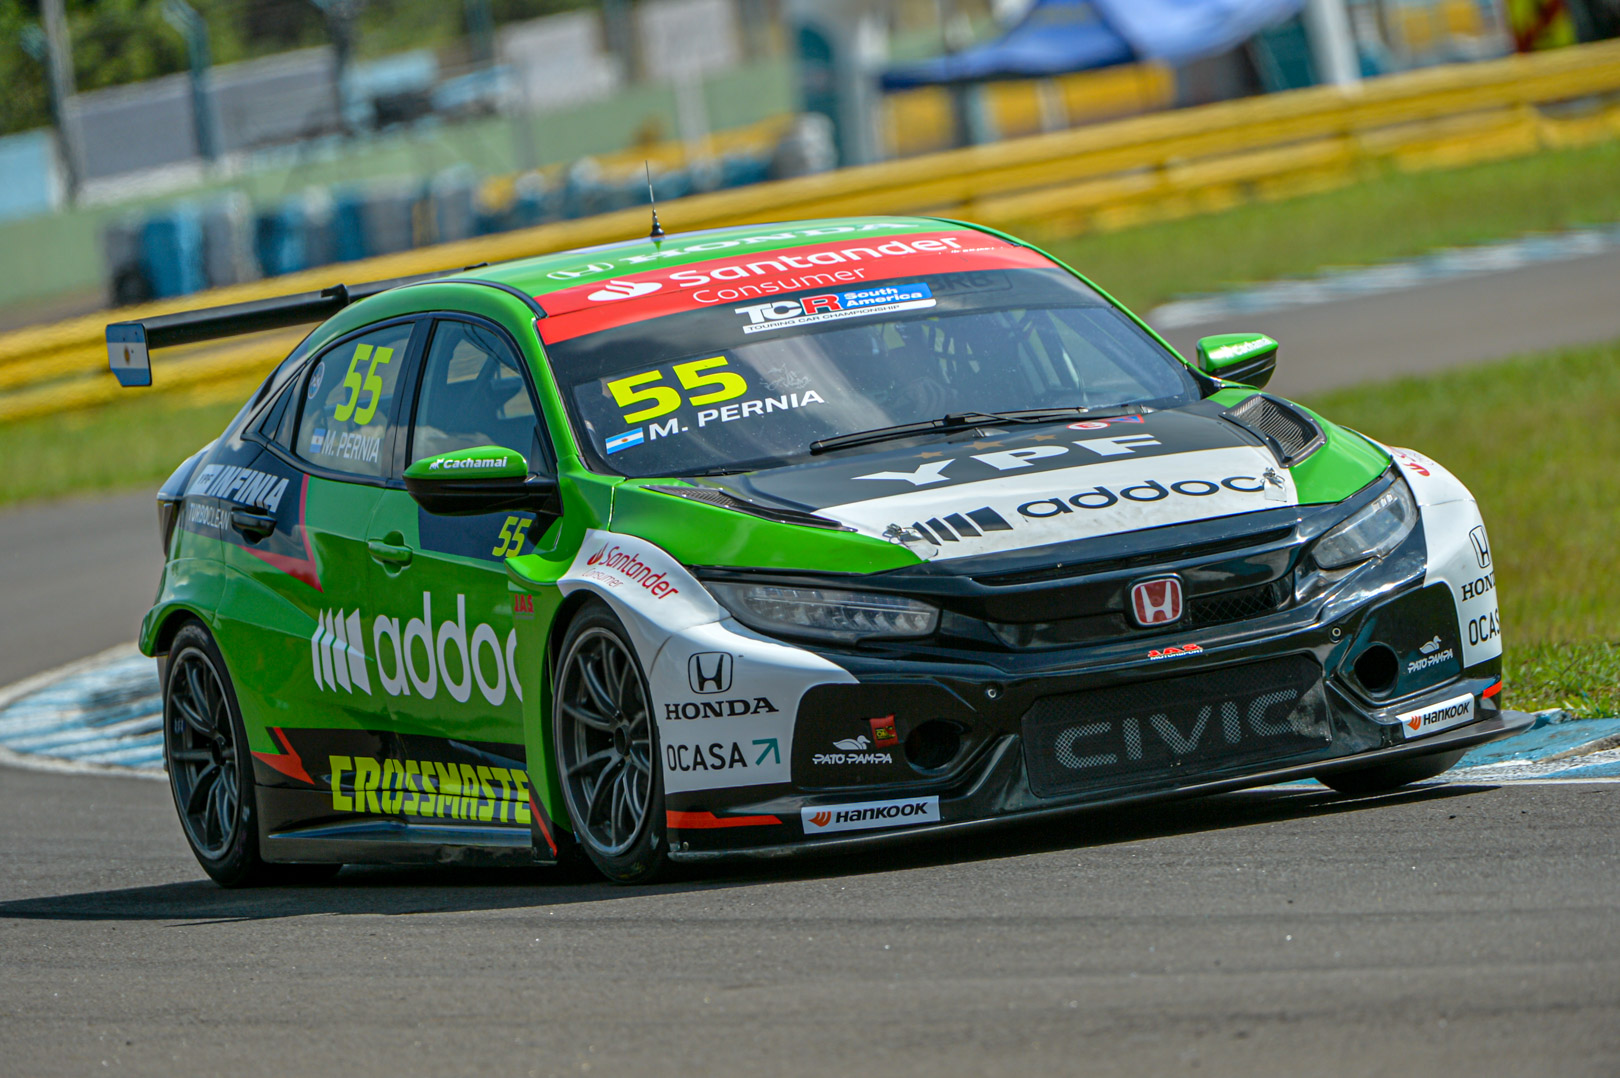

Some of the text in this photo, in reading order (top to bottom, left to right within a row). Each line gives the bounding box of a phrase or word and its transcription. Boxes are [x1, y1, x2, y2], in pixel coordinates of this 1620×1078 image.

[619, 222, 919, 264] HONDA
[669, 237, 961, 287] Santander
[693, 266, 865, 303] Consumer
[844, 287, 898, 299] South
[847, 292, 922, 308] America
[735, 293, 843, 324] TCR
[748, 304, 900, 331] TOURING CAR CHAMPIONSHIP
[334, 343, 394, 426] 55
[607, 355, 748, 424] 55
[649, 389, 825, 441] M. PERNIA
[321, 429, 381, 464] M. PERNIA
[443, 456, 508, 469] Cachamai
[851, 433, 1163, 486] YPF
[205, 465, 290, 514] INFINIA
[1016, 475, 1266, 518] addoc
[492, 516, 533, 558] 55
[598, 546, 679, 599] Santander
[1461, 570, 1497, 602] HON
[1407, 648, 1453, 674] PATO PAMPA
[664, 697, 779, 720] HONDA
[1055, 689, 1300, 769] CIVIC
[667, 742, 748, 772] OCASA
[812, 753, 893, 765] PATO PAMPA
